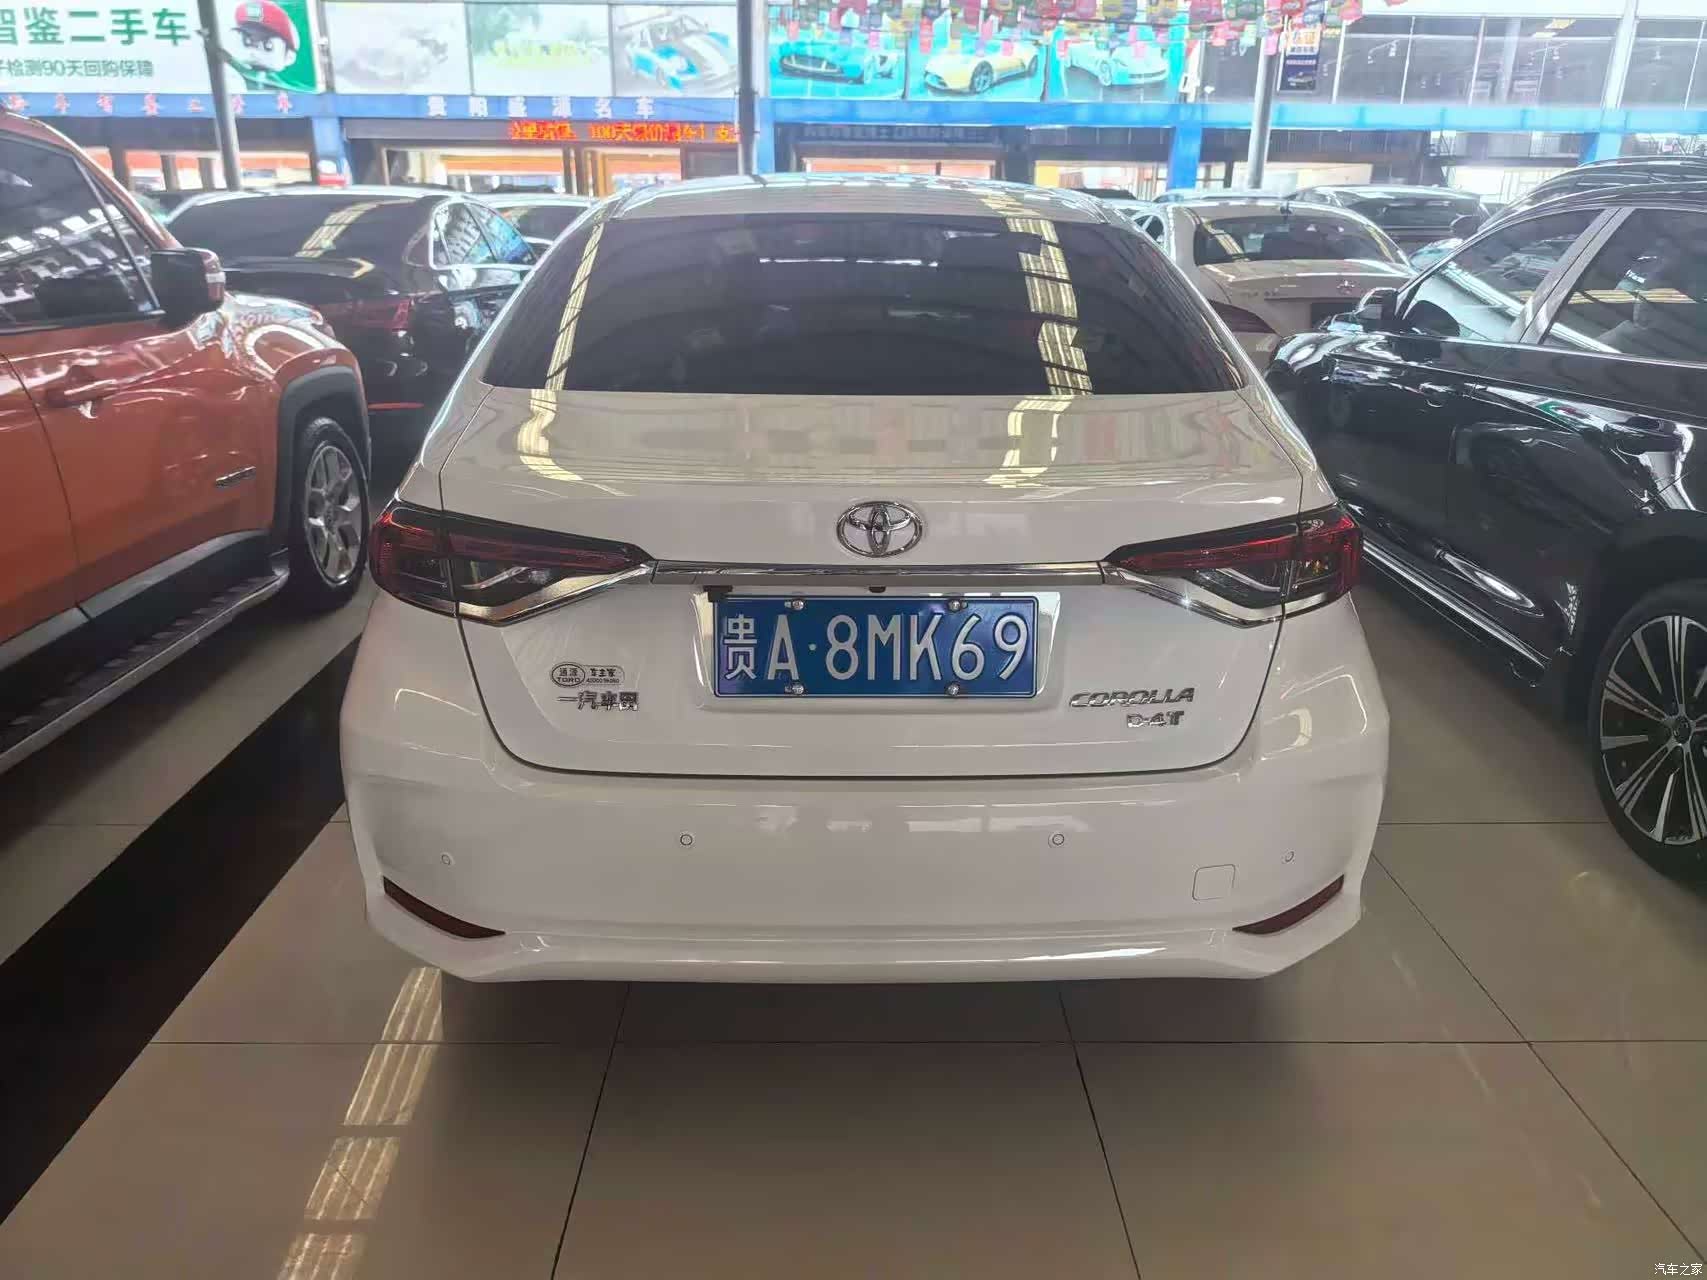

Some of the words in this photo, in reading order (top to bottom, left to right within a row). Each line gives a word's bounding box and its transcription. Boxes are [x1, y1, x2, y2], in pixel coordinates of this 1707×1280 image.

[723, 612, 1028, 682] 贵A·8MK69
[1069, 687, 1195, 708] COROLLA
[1126, 711, 1185, 728] D-4T
